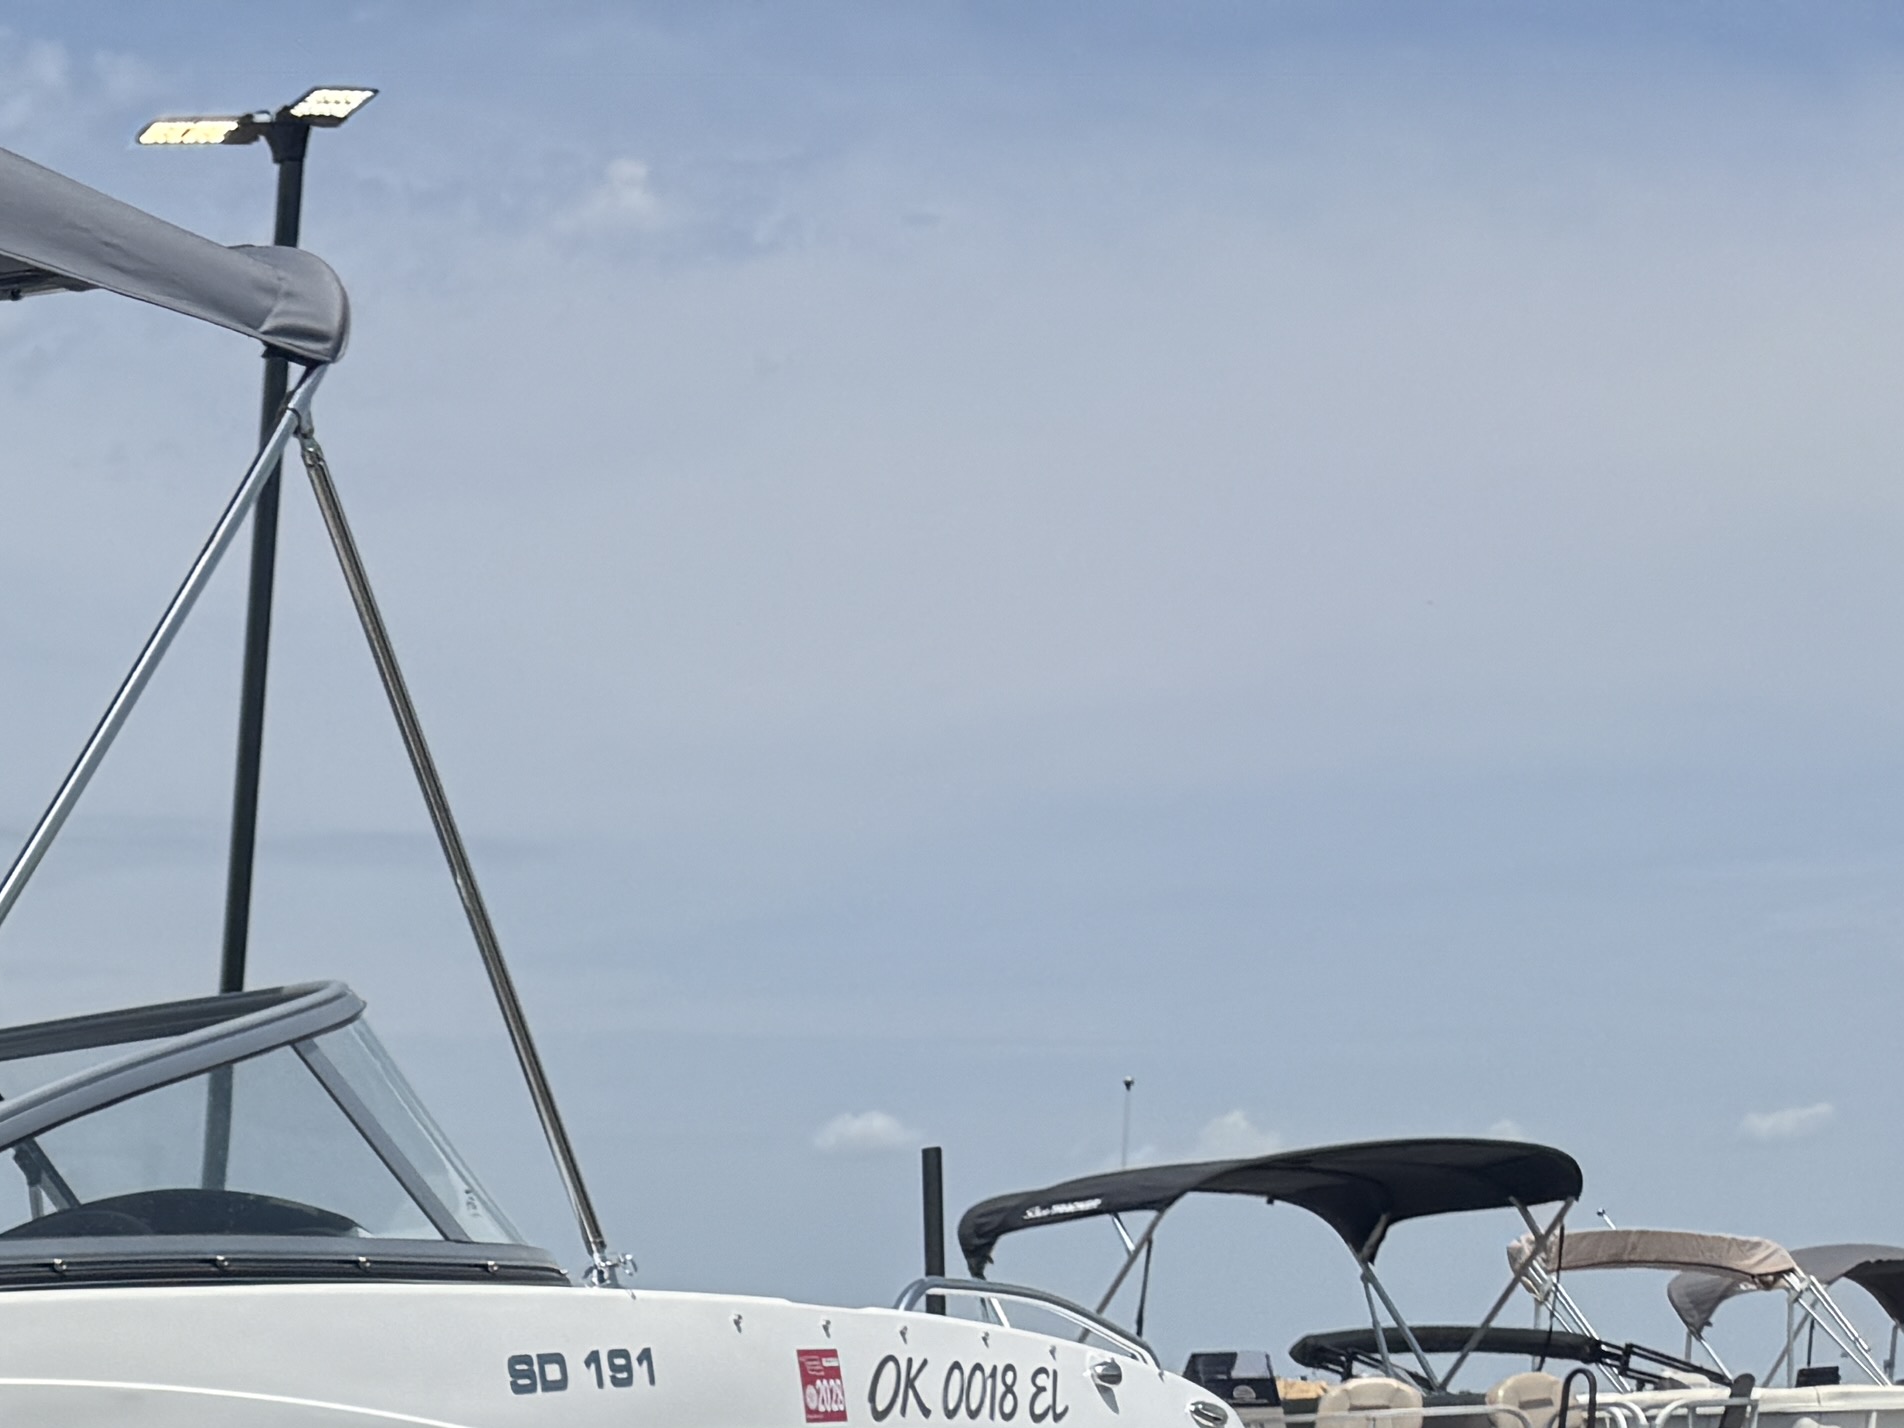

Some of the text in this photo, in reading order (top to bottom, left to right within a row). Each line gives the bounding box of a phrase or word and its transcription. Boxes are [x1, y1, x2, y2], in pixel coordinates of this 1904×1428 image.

[507, 1347, 656, 1395] SD 191
[867, 1354, 932, 1423] OK
[942, 1360, 1019, 1422] 0018
